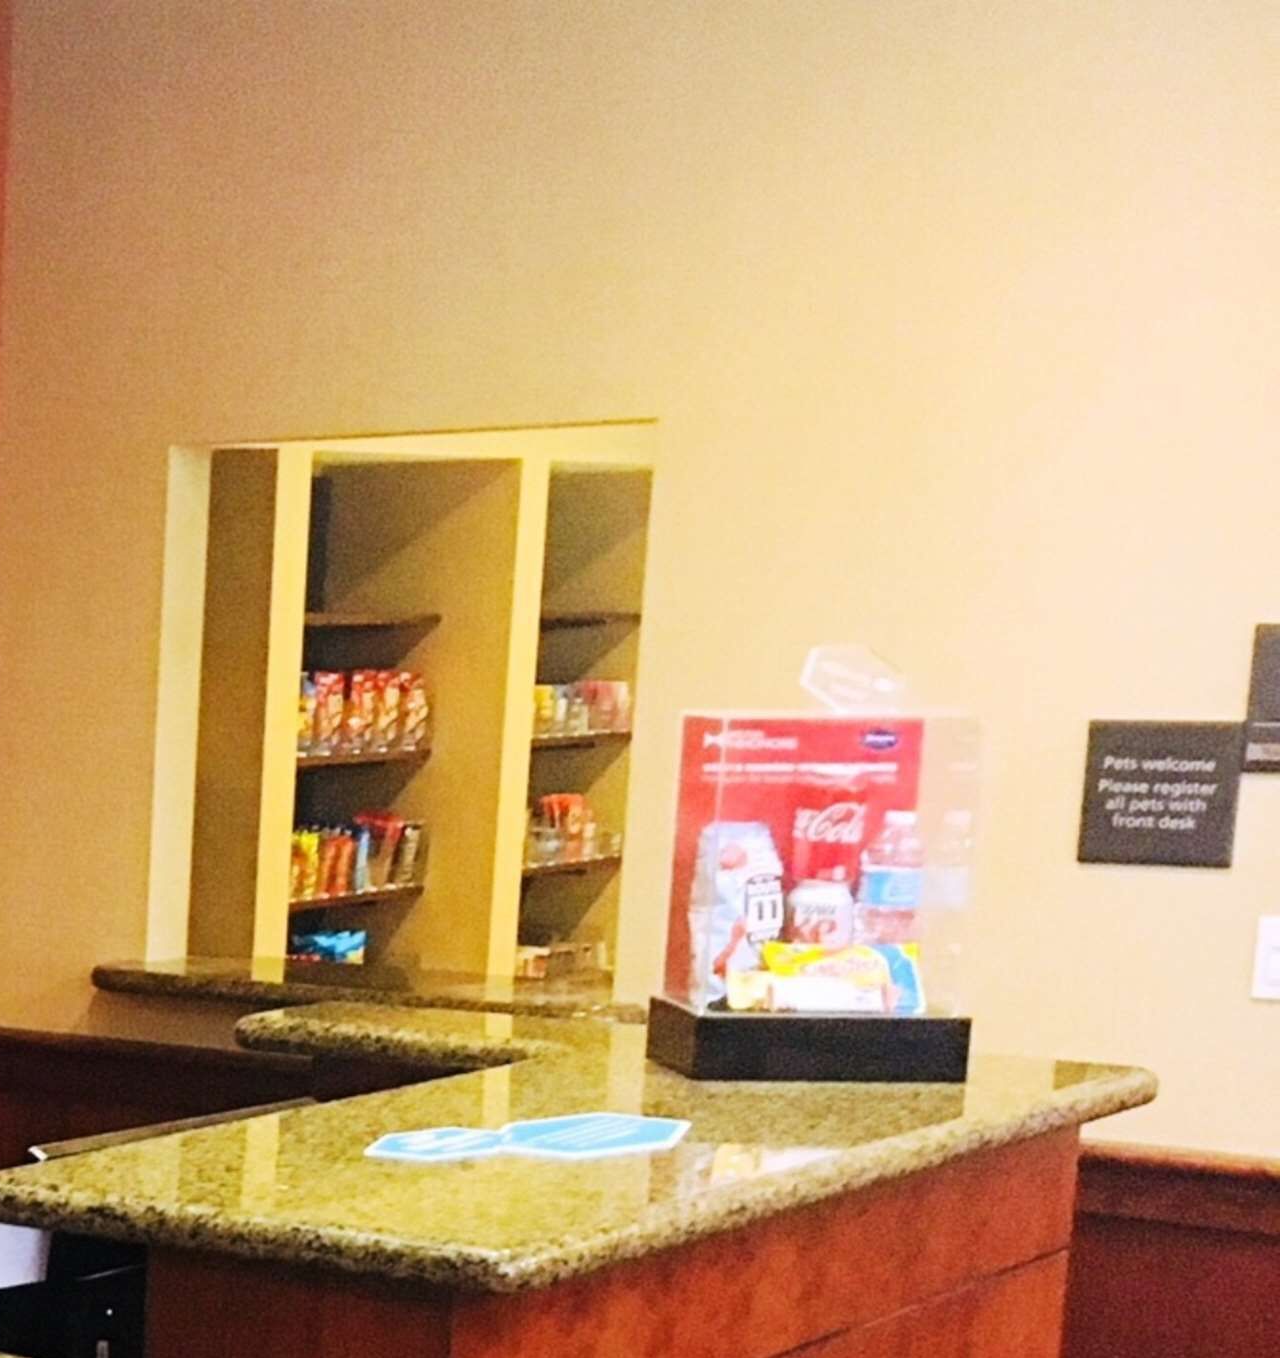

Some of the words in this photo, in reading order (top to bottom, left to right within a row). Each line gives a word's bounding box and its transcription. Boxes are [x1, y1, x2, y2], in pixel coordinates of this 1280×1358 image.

[1103, 755, 1138, 771] Pets
[1141, 756, 1217, 772] welcome
[1097, 779, 1150, 793] Please
[1152, 780, 1218, 798] register
[1105, 796, 1126, 810] all
[1128, 799, 1164, 813] pets
[1168, 798, 1207, 812] with
[1111, 812, 1154, 828] front
[1158, 815, 1197, 830] desk
